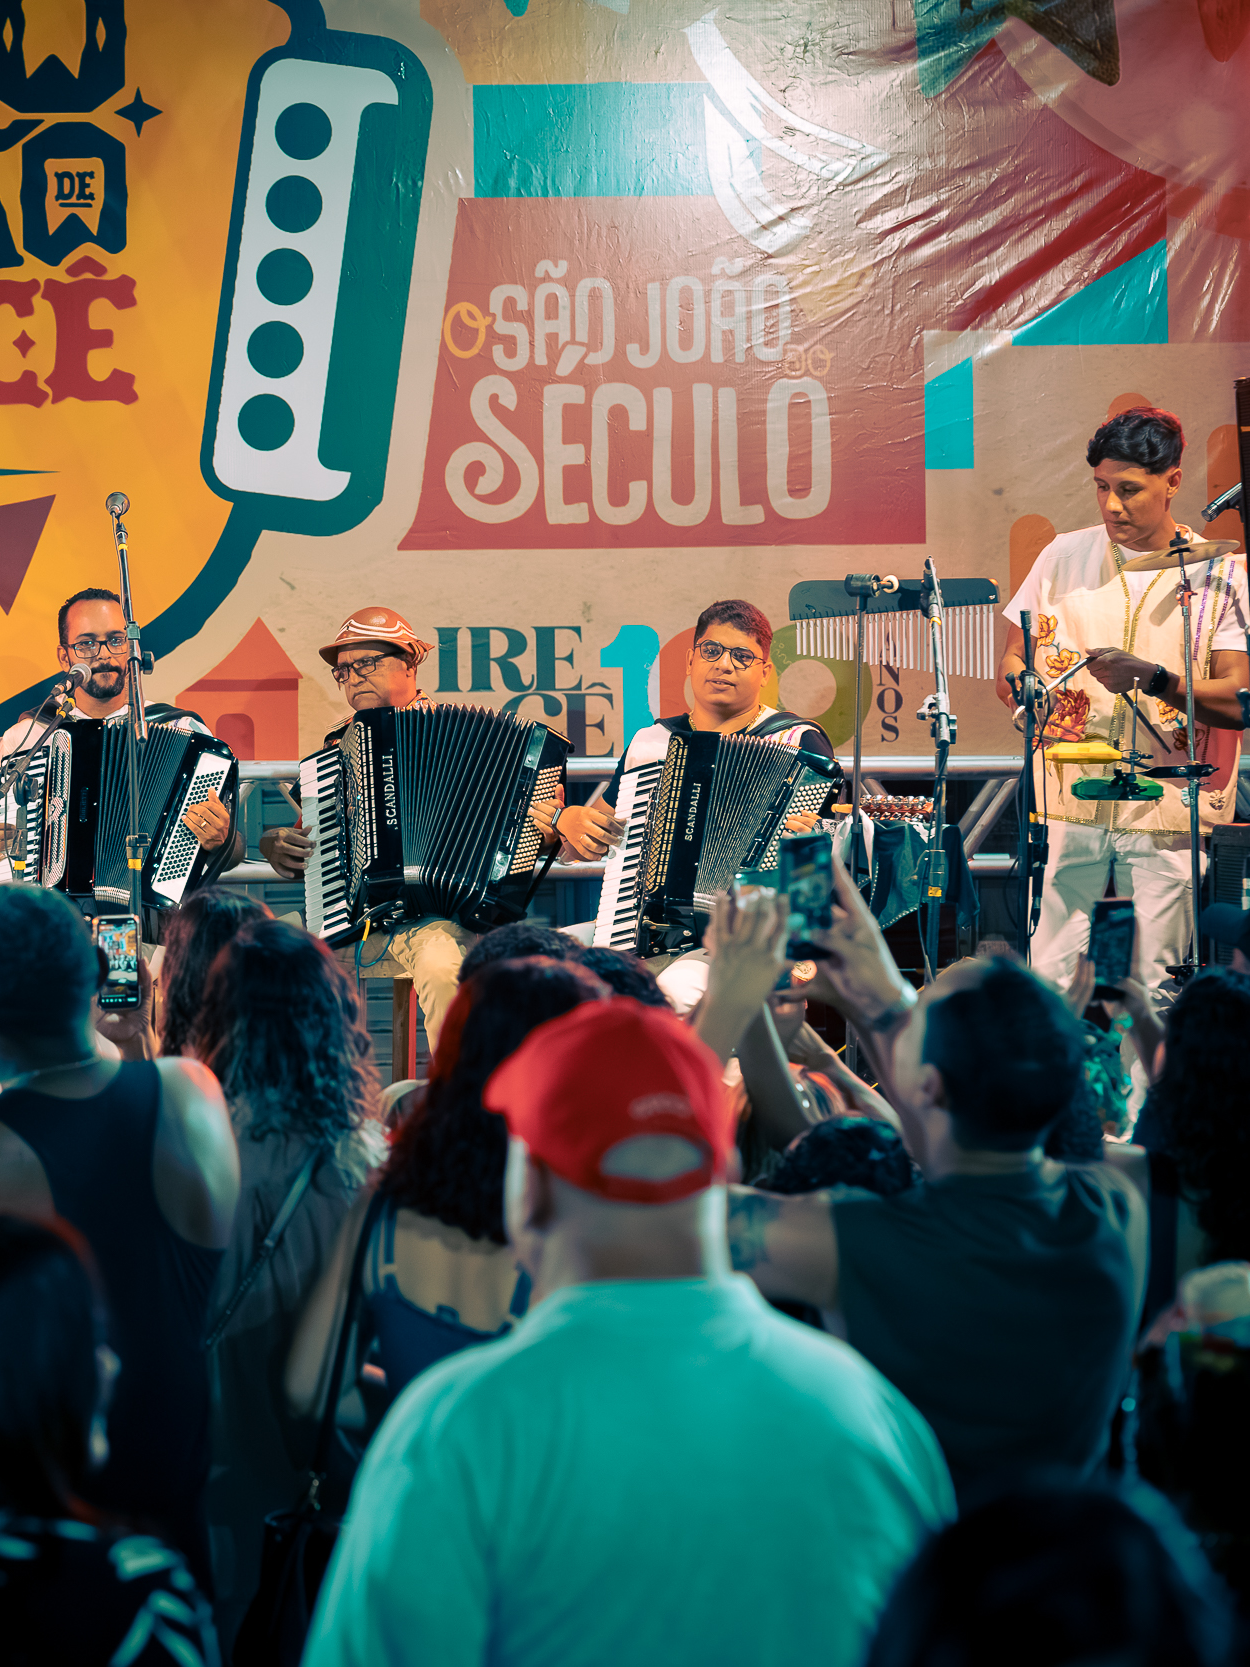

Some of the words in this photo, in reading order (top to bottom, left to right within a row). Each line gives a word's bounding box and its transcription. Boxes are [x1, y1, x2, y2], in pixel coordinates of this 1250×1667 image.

[54, 171, 96, 202] DE
[444, 301, 492, 359] O
[490, 259, 615, 372] SÃO
[626, 256, 792, 369] JOÃO
[445, 344, 832, 527] SÉCULO
[434, 625, 583, 693] IRE
[382, 754, 398, 826] SCANDALLI
[684, 783, 701, 841] SCANDALLI
